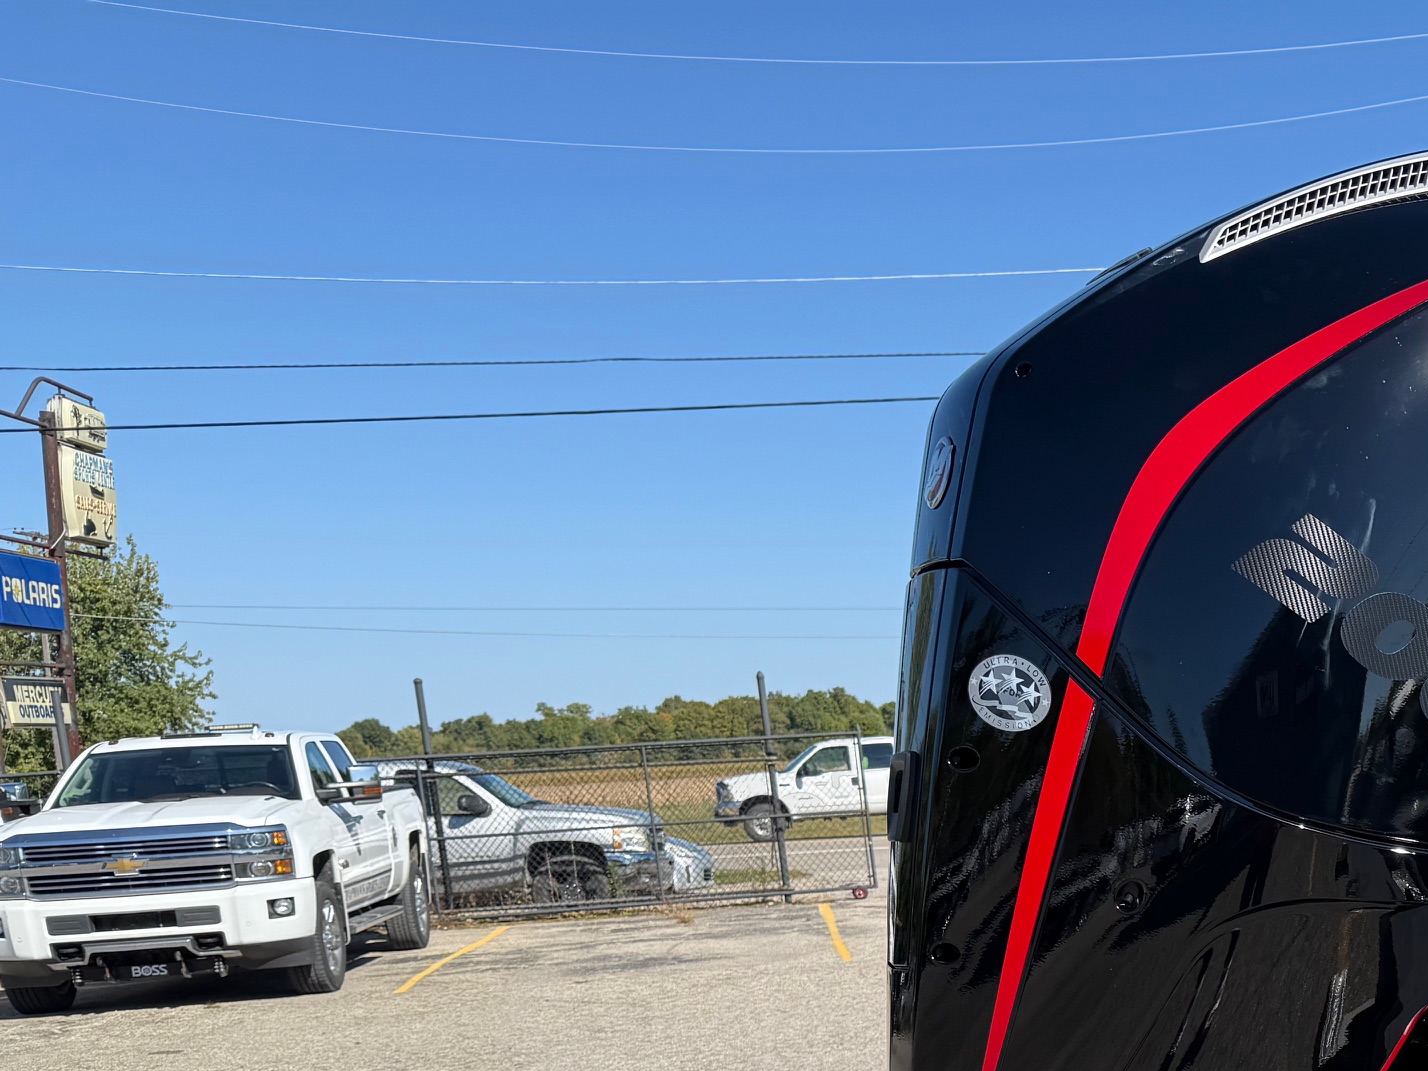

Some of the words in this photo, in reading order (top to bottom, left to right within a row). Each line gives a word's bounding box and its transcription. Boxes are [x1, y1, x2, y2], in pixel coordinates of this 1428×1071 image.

[2, 576, 61, 609] POLARIS
[984, 656, 1018, 669] ULTRA
[1026, 665, 1047, 687] LOW
[13, 684, 62, 704] MERCU
[131, 964, 168, 978] BOSS
